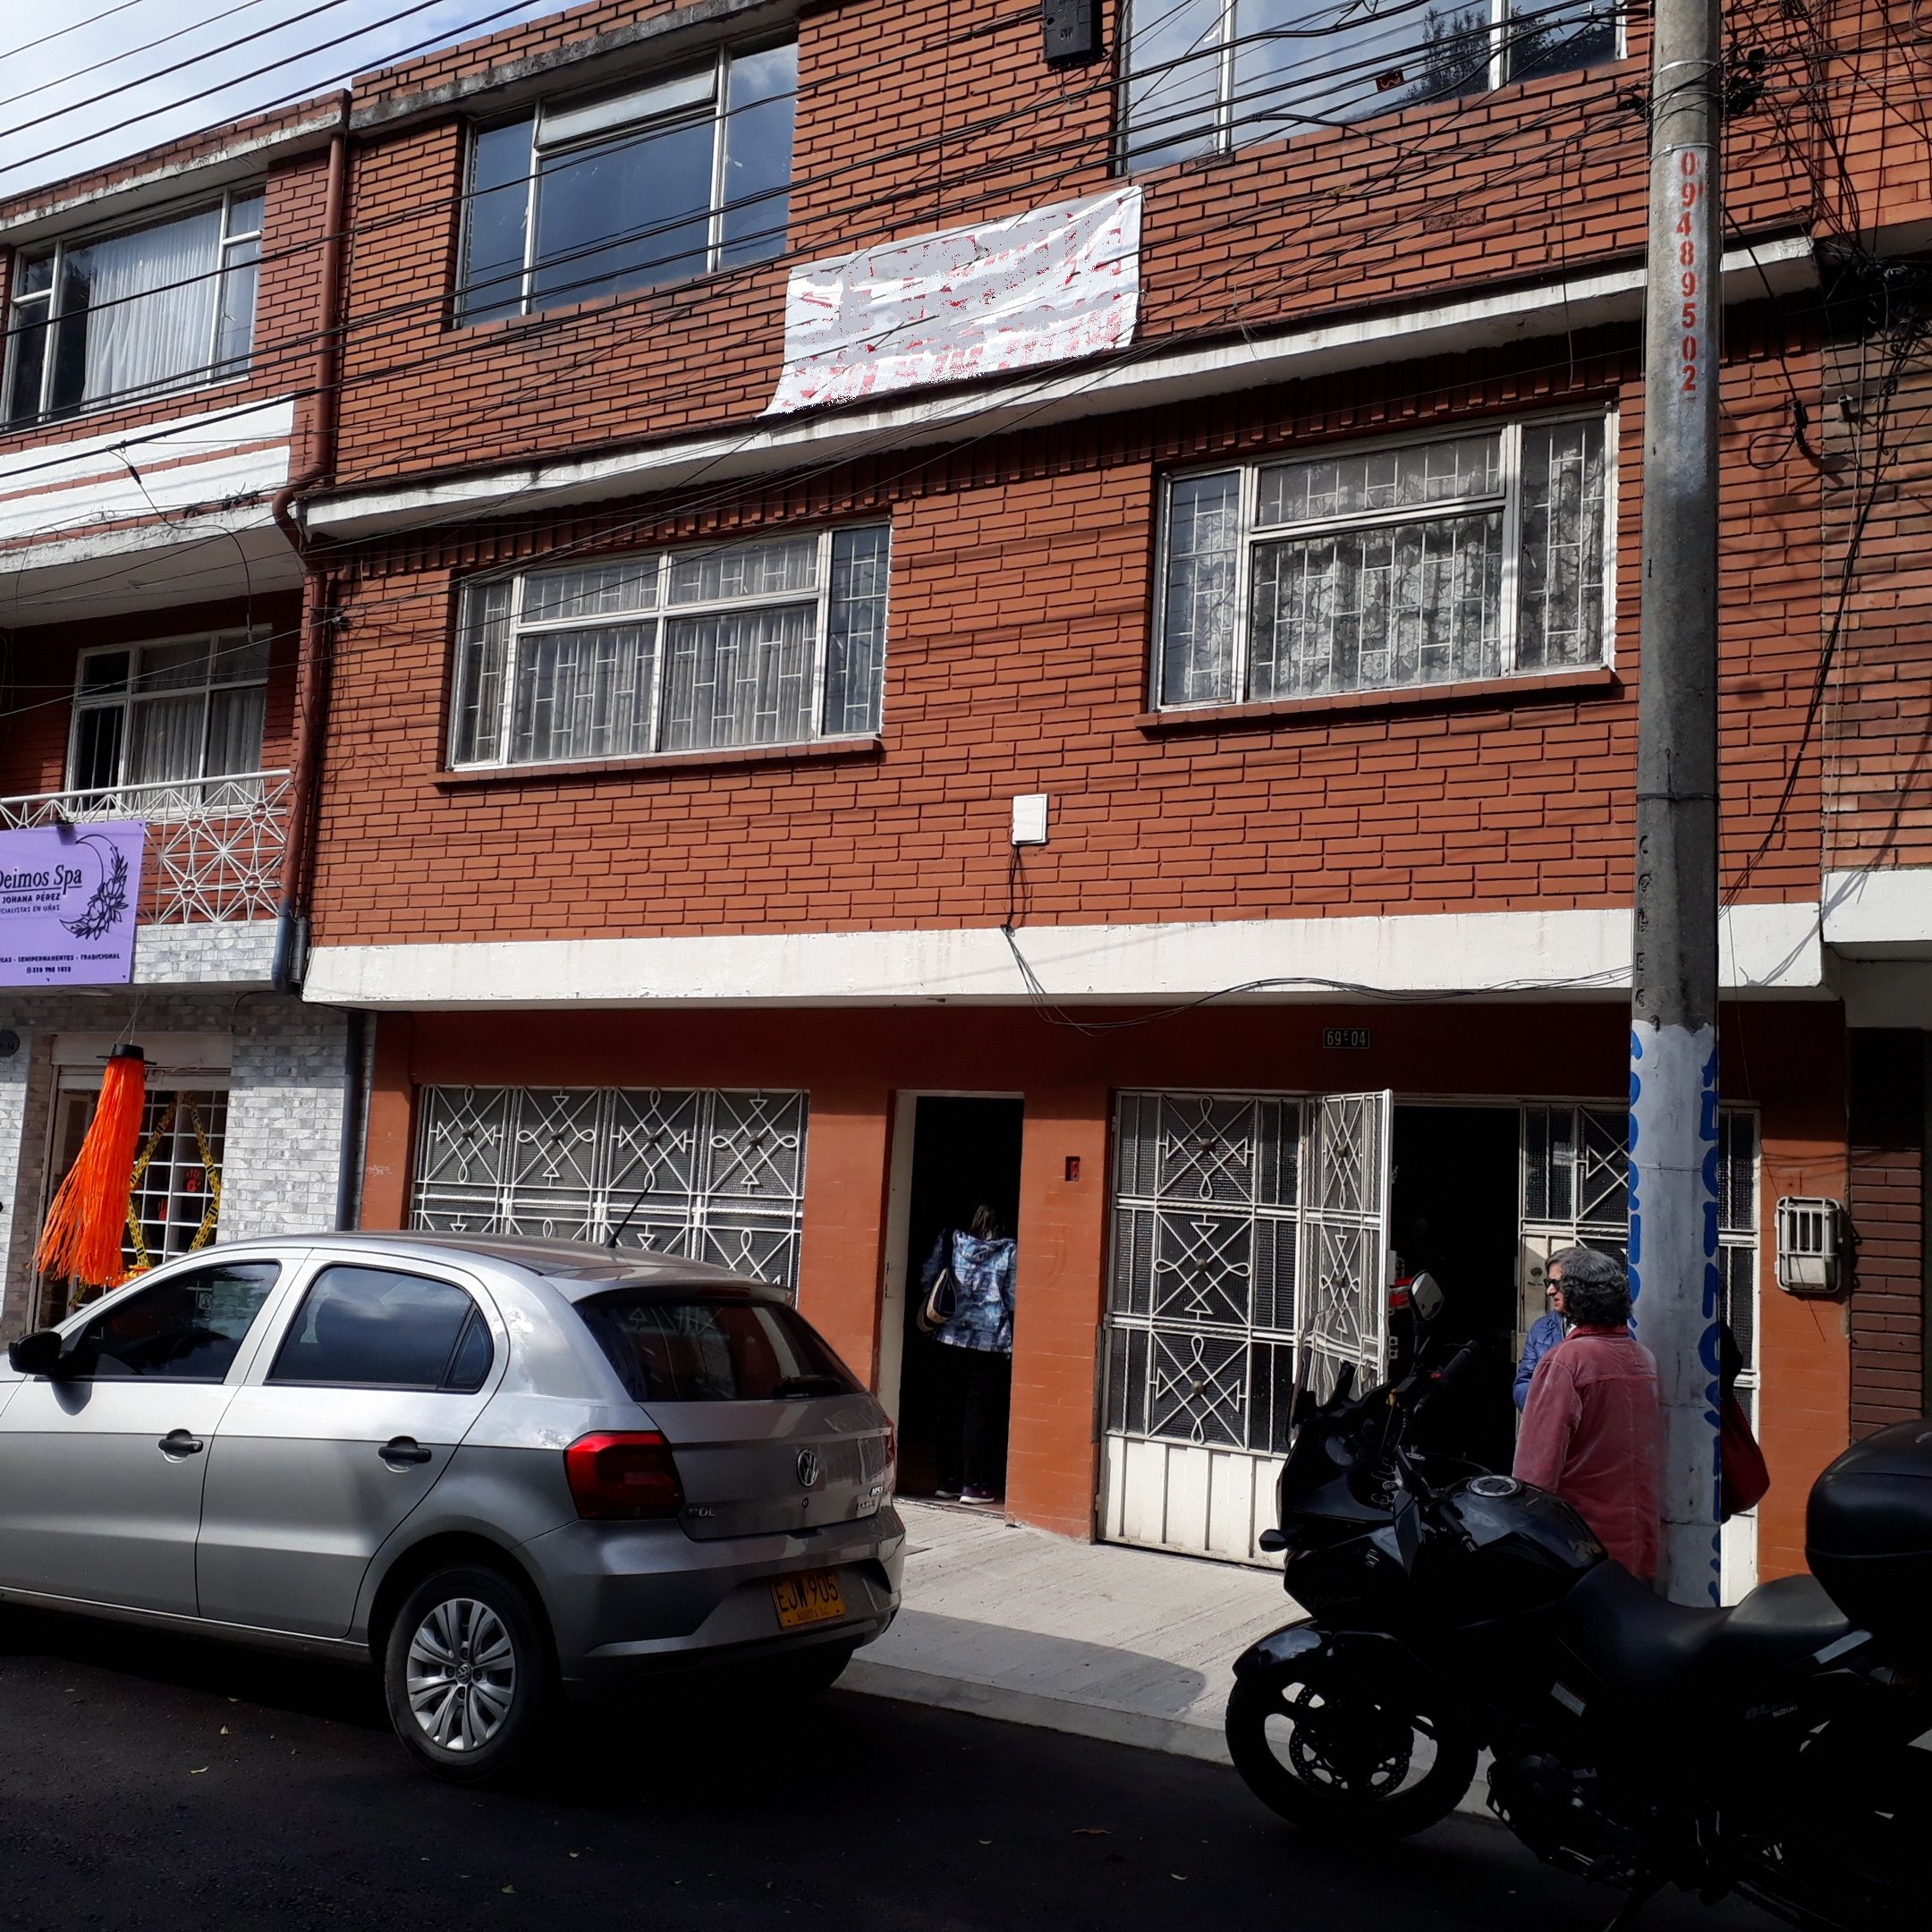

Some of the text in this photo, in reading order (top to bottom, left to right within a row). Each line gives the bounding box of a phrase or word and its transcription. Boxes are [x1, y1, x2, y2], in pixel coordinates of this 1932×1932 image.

[1676, 150, 1699, 391] 09489502
[54, 864, 82, 895] Spa
[2, 894, 33, 904] JOHANA
[0, 906, 30, 914] CIALISTAS
[80, 953, 121, 961] TRADICIONAL
[809, 1574, 839, 1606] 905
